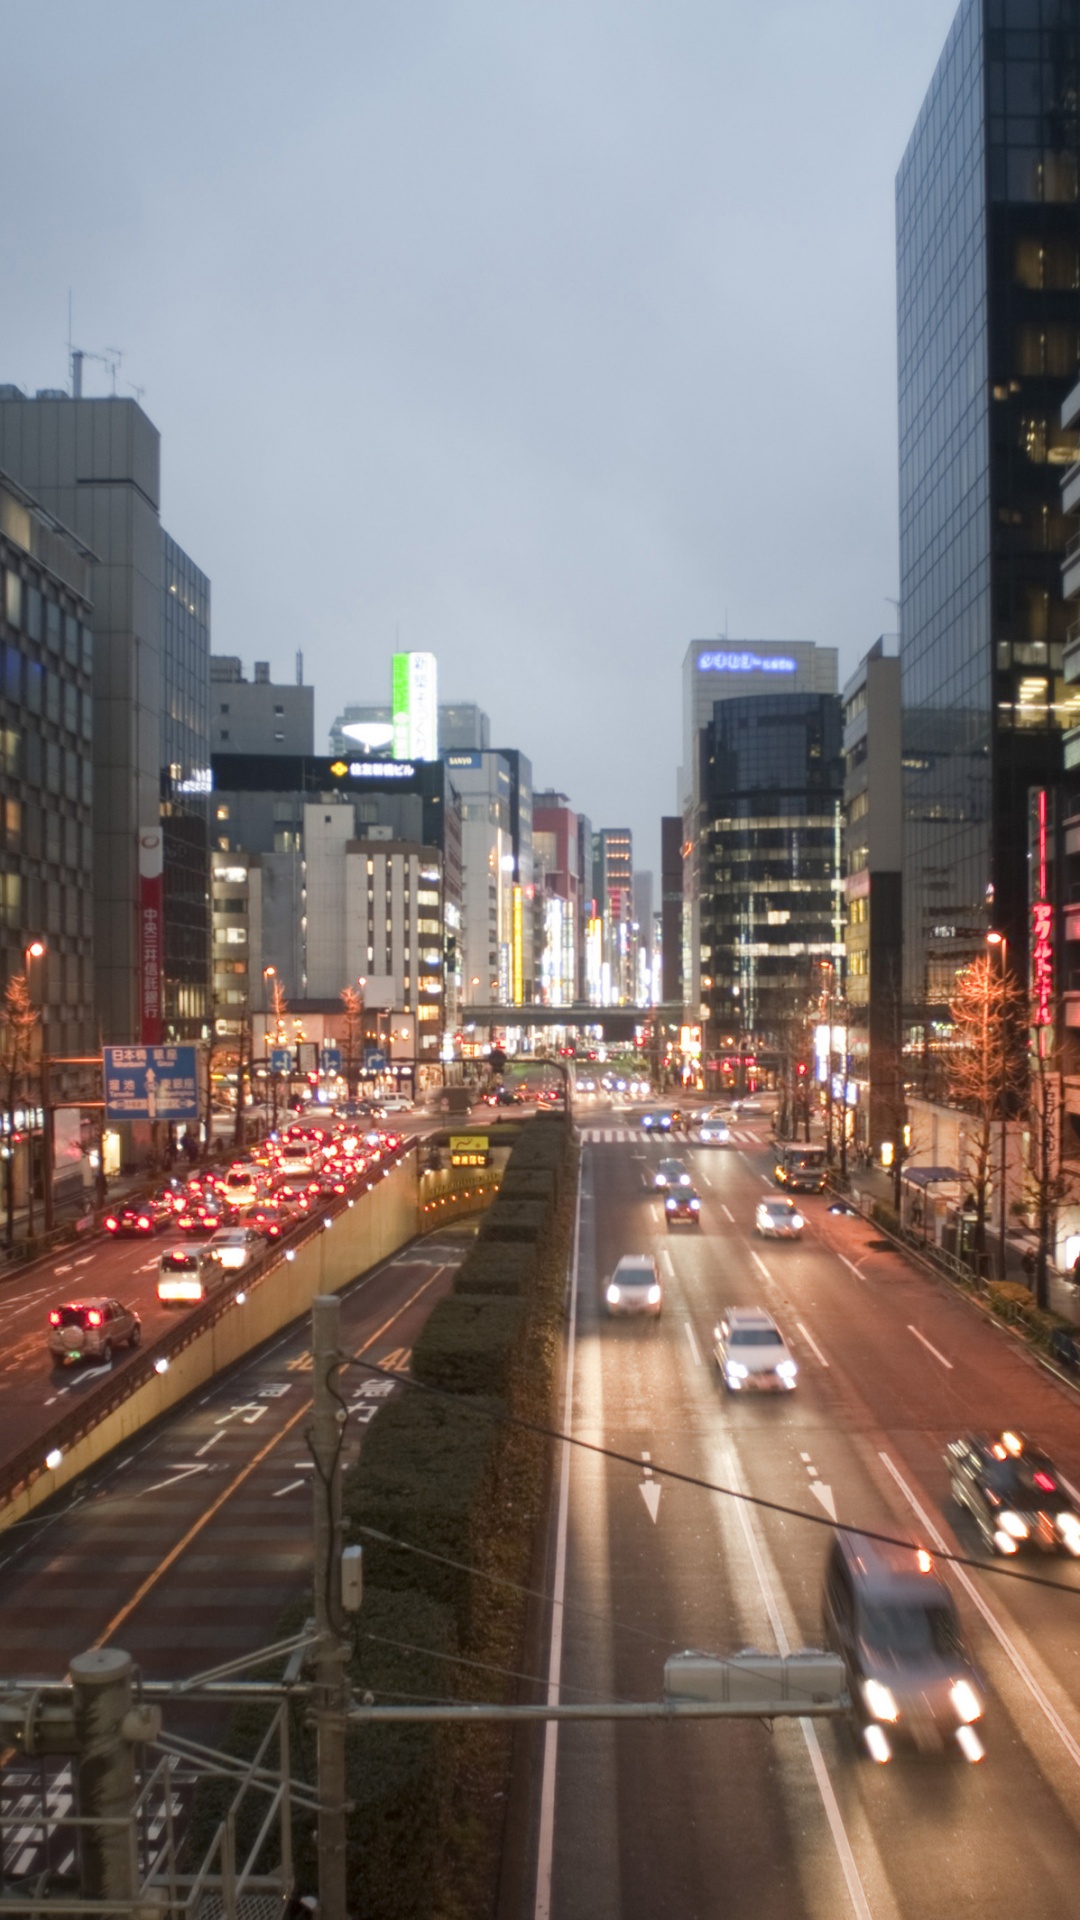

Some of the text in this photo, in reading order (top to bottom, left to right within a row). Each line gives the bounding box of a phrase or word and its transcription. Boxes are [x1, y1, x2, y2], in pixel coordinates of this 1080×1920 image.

[449, 757, 472, 765] SANYO
[144, 909, 158, 1018] 中央三井信託銀行
[112, 1049, 147, 1061] 日本橋
